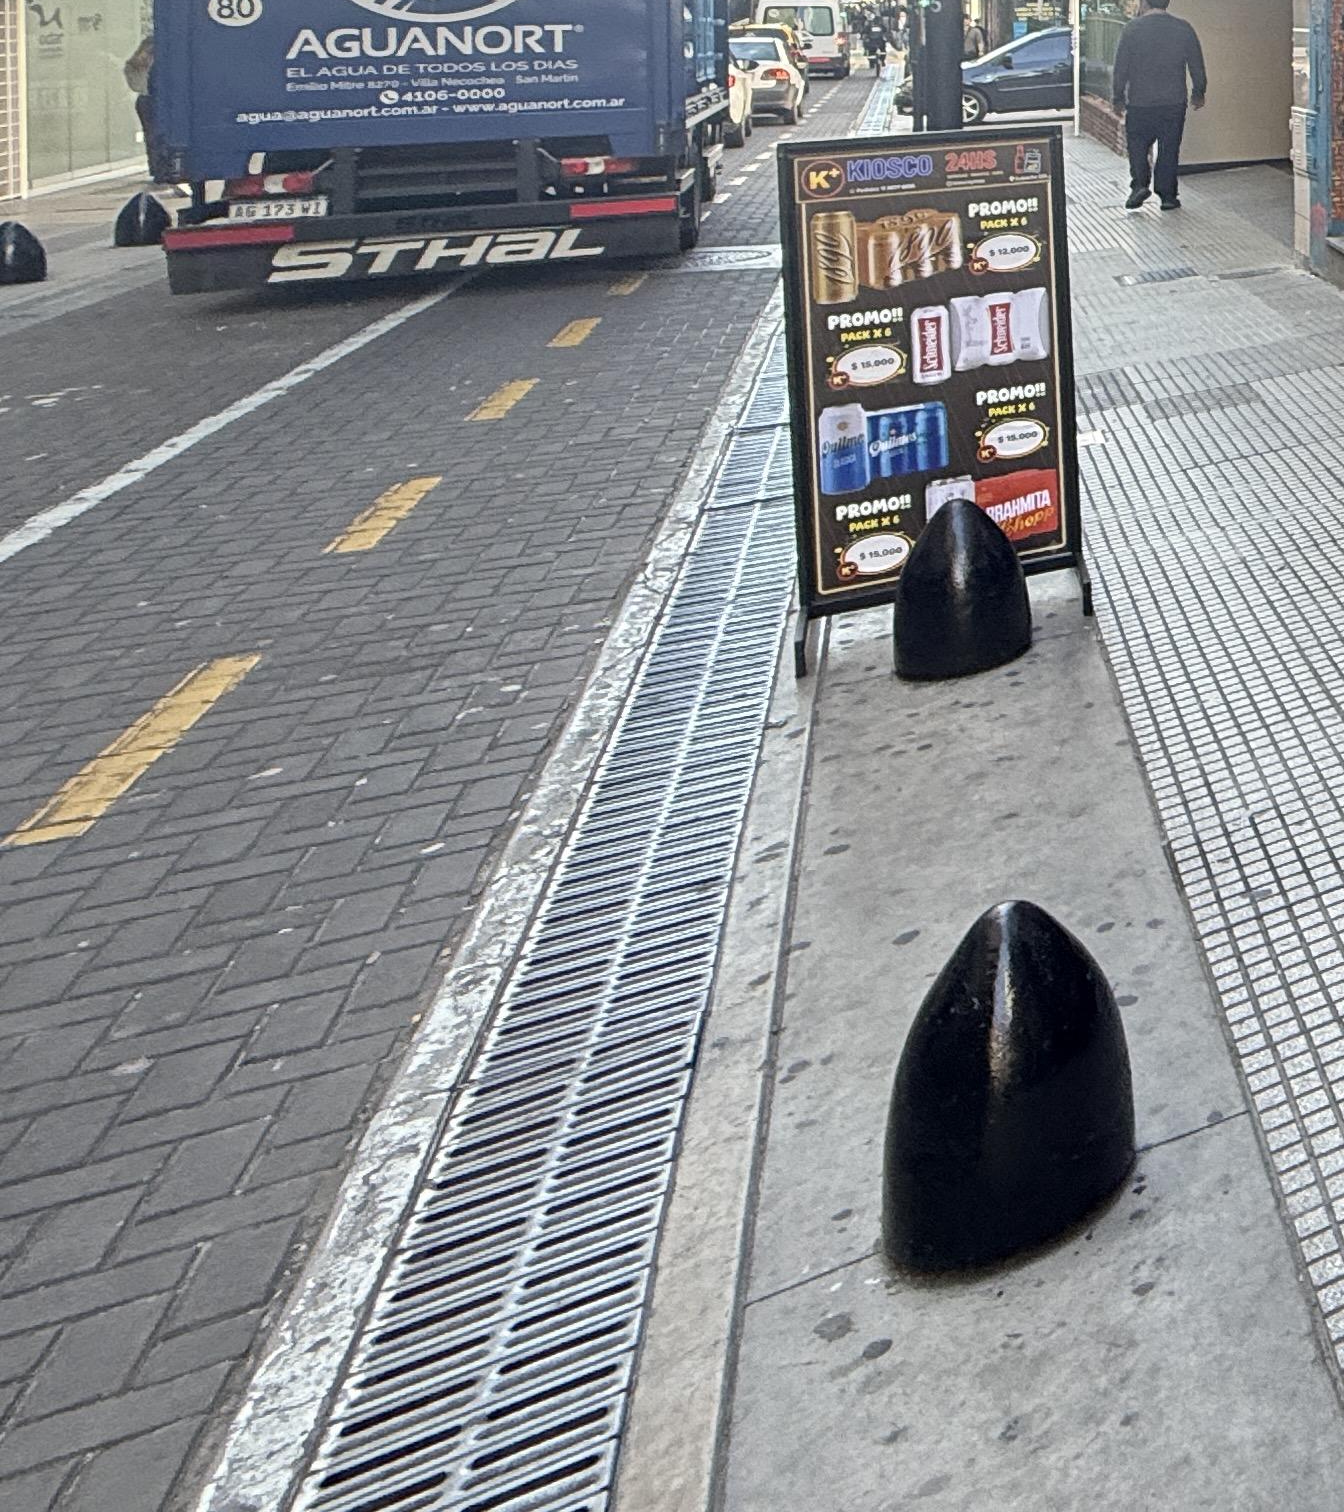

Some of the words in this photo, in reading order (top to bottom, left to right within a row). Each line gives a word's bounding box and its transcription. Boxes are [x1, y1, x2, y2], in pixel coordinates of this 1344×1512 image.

[286, 24, 574, 59] AGUANORT
[286, 67, 312, 78] EL
[316, 65, 378, 77] AGUA
[383, 64, 410, 75] DE
[415, 62, 486, 73] TODOS
[491, 61, 529, 72] LOS
[533, 59, 578, 70] DIAS
[330, 80, 365, 90] Mitre
[516, 75, 539, 84] San
[402, 87, 506, 101] 4106-0000
[236, 104, 438, 125] agua@aguanort.com.ar
[453, 97, 626, 114] www.aguanort.com.ar
[846, 154, 933, 181] KIOSCO
[945, 149, 997, 172] 24HS
[235, 203, 257, 217] AG
[264, 202, 295, 217] 173
[968, 197, 1039, 218] PROMO!!
[980, 218, 1008, 230] PACK
[1020, 217, 1028, 226] 6
[827, 307, 903, 330] PROMO!!
[841, 331, 870, 342] PACK
[884, 328, 892, 337] 6
[991, 305, 1012, 355] Schneider
[922, 320, 943, 372] Schneider
[861, 357, 895, 369] 15.000
[976, 382, 1046, 406] PROMO!!
[989, 406, 1016, 418] PACK
[1028, 403, 1036, 412] 6
[836, 494, 911, 521] PROMO!!
[986, 489, 1051, 523] BRAHMITA
[849, 520, 878, 532] PACK
[893, 515, 900, 524] 6
